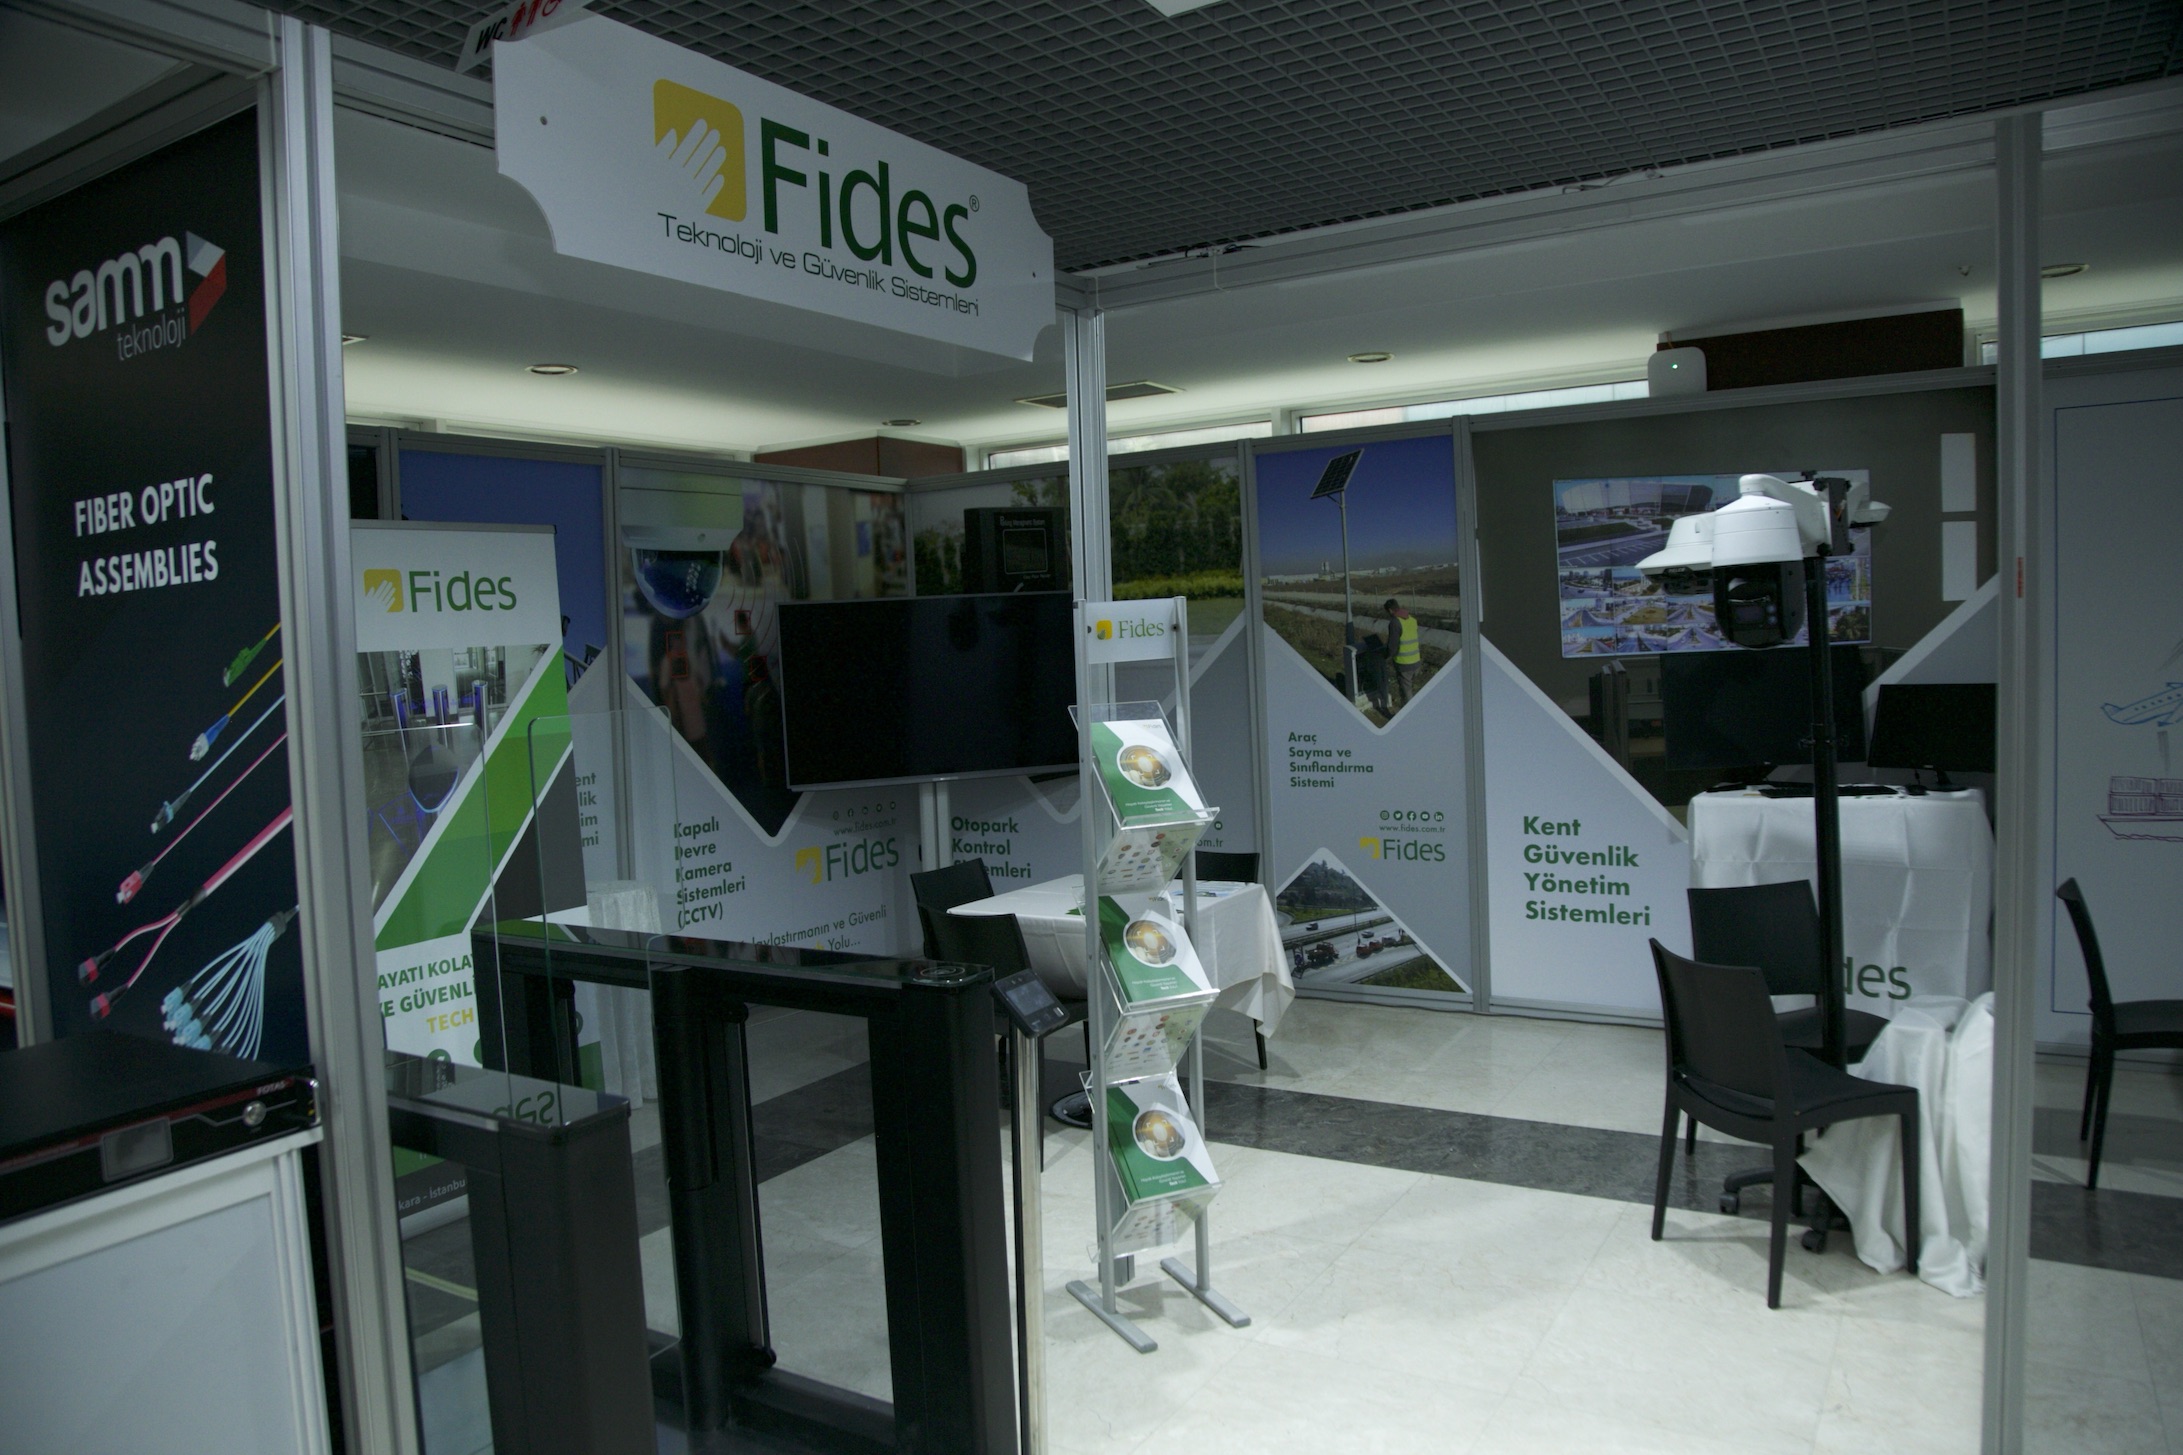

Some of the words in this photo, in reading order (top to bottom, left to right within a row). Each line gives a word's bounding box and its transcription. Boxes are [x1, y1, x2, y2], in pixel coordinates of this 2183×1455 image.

[475, 17, 507, 54] WC
[658, 212, 763, 266] Teknoloji
[770, 248, 796, 269] ve
[803, 252, 886, 293] Güvenlik
[892, 276, 979, 317] Sistemleri
[45, 236, 184, 347] samm
[116, 307, 186, 361] teknoloji
[75, 491, 136, 537] FIBER
[140, 473, 215, 524] OPTIC
[78, 540, 219, 597] ASSEMBLIES
[408, 571, 517, 612] Fides
[1118, 617, 1165, 639] Fides
[1288, 732, 1317, 744] Araç
[1289, 747, 1332, 761] Sayma
[1337, 749, 1351, 758] ve
[1289, 761, 1374, 773] Sınıflandırma
[575, 773, 597, 787] ent
[1290, 776, 1335, 788] Sistemi
[674, 816, 719, 840] Kapalı
[951, 816, 1019, 837] Otopark
[1379, 824, 1446, 834] www.fides.com.tr
[1523, 816, 1581, 836] Kent
[674, 843, 717, 861] Devre
[952, 838, 1011, 855] Kontrol
[1383, 839, 1446, 861] Fides
[1523, 844, 1639, 867] Güvenlik
[826, 838, 899, 881] Fides
[675, 862, 732, 883] Kamera
[1524, 872, 1630, 896] Yönetim
[677, 876, 746, 905] Sistemleri
[678, 901, 723, 929] (CCTV)
[833, 920, 846, 930] ve
[848, 905, 887, 926] Güvenli
[1525, 901, 1651, 926] Sistemleri
[378, 966, 424, 989] AYATI
[428, 954, 473, 977] KOLA
[426, 1007, 474, 1034] TECH
[398, 1194, 421, 1210] kara
[429, 1178, 466, 1199] İstanbu
